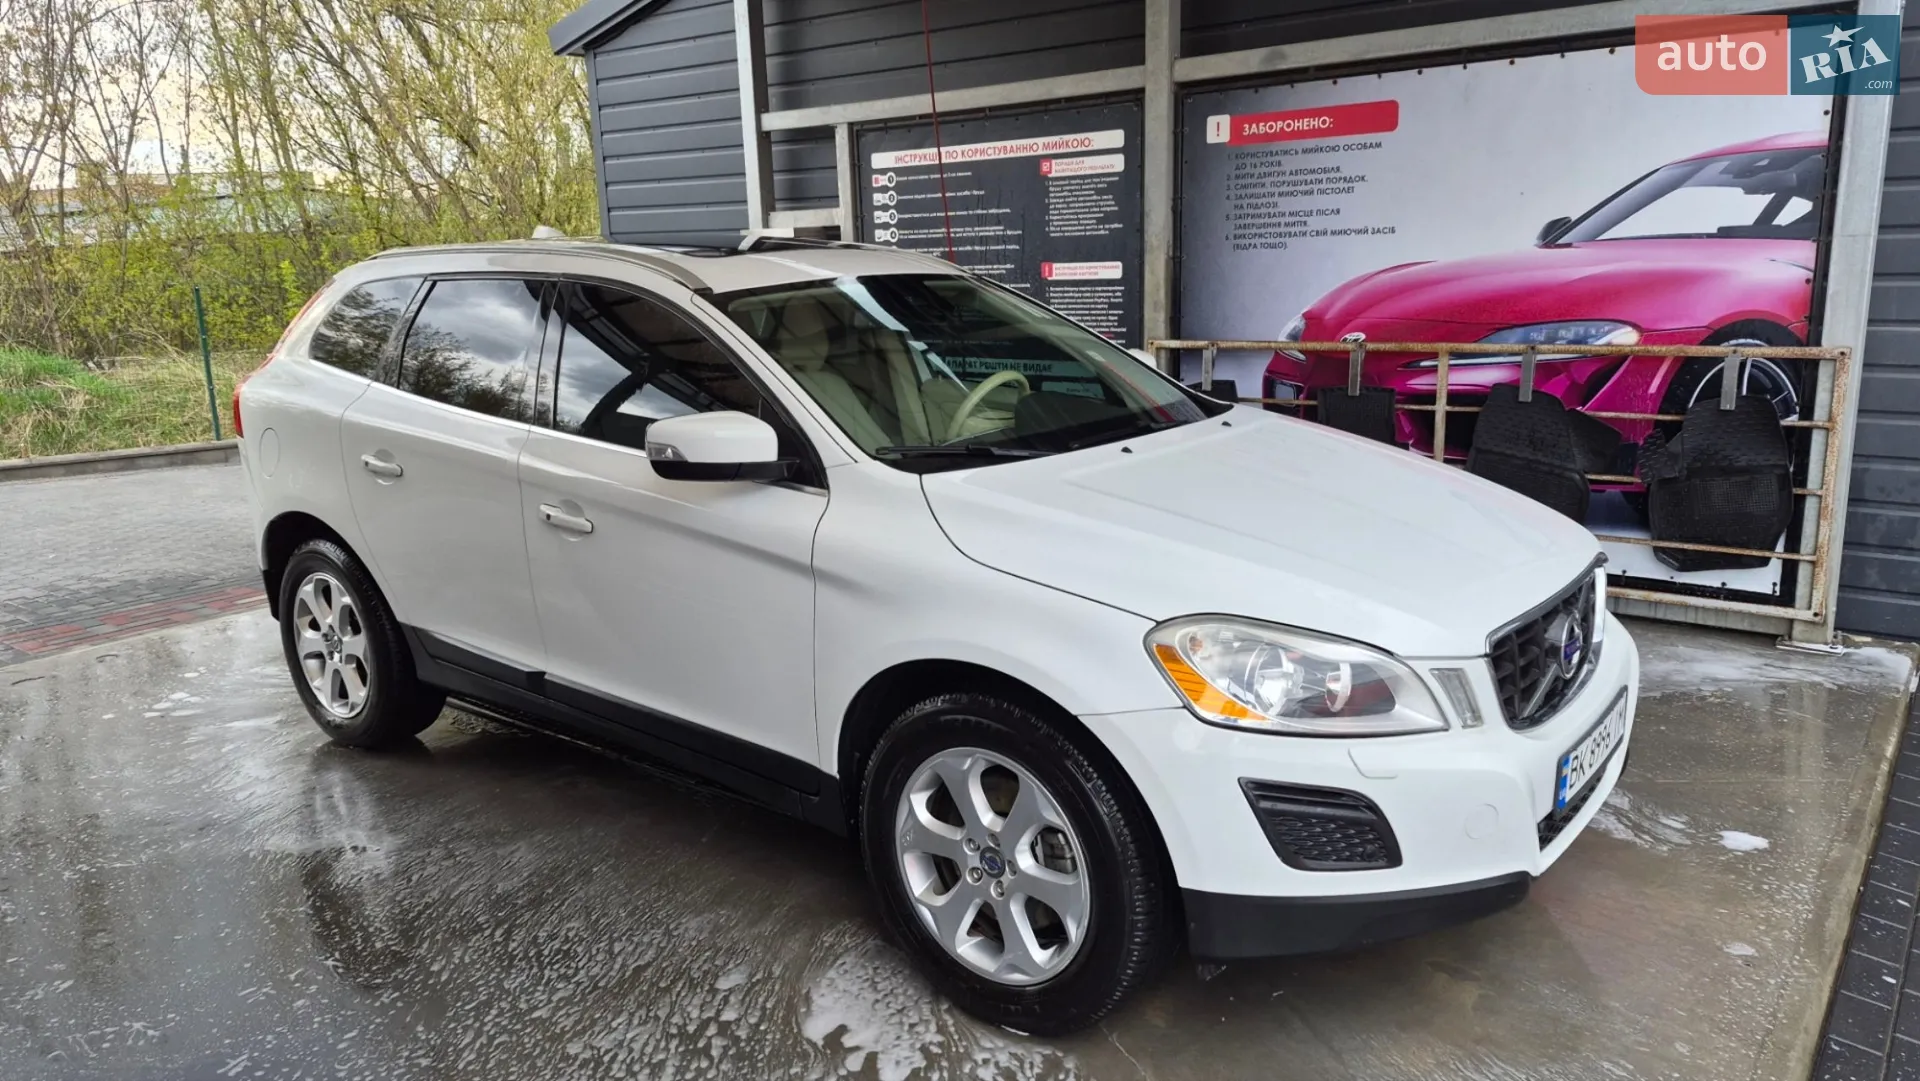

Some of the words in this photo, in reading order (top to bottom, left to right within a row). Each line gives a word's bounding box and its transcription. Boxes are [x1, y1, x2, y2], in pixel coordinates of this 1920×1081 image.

[1242, 116, 1334, 136] ЗАБОРОНЕНО:
[894, 151, 942, 165] ІНСТРУКЦІ
[945, 150, 958, 161] ПО
[961, 142, 1040, 160] КОРИСТУВАННЮ
[1041, 136, 1094, 153] МИЙКОЮ:
[1235, 148, 1299, 160] КОРИСТУВАТИСЬ
[1301, 145, 1341, 155] МИЙКОЮ
[1342, 141, 1383, 152] ОСОБАМ
[1234, 162, 1247, 172] ДО
[1234, 172, 1255, 181] МИТИ
[1256, 169, 1287, 180] ДВИГУН
[1270, 177, 1324, 188] ПОРУШУВАТИ
[1234, 191, 1276, 201] ЗАЛИШАТИ
[1277, 187, 1315, 199] МИЮЧИЙ
[1316, 186, 1355, 196] ПІСТОЛЕТ
[1233, 203, 1245, 211] НА
[1233, 210, 1286, 221] ЗАТРИМУВАТИ
[1287, 208, 1314, 218] МІСЦЕ
[1315, 207, 1341, 217] ПІСЛЯ
[1233, 221, 1282, 231] ЗАВЕРШЕННЯ
[1233, 229, 1308, 241] ВИКОРИСТОВУВАТИ
[1309, 227, 1329, 238] СВІЙ
[1329, 225, 1370, 237] МИЮЧИЙ
[1370, 226, 1396, 236] ЗАСІБ
